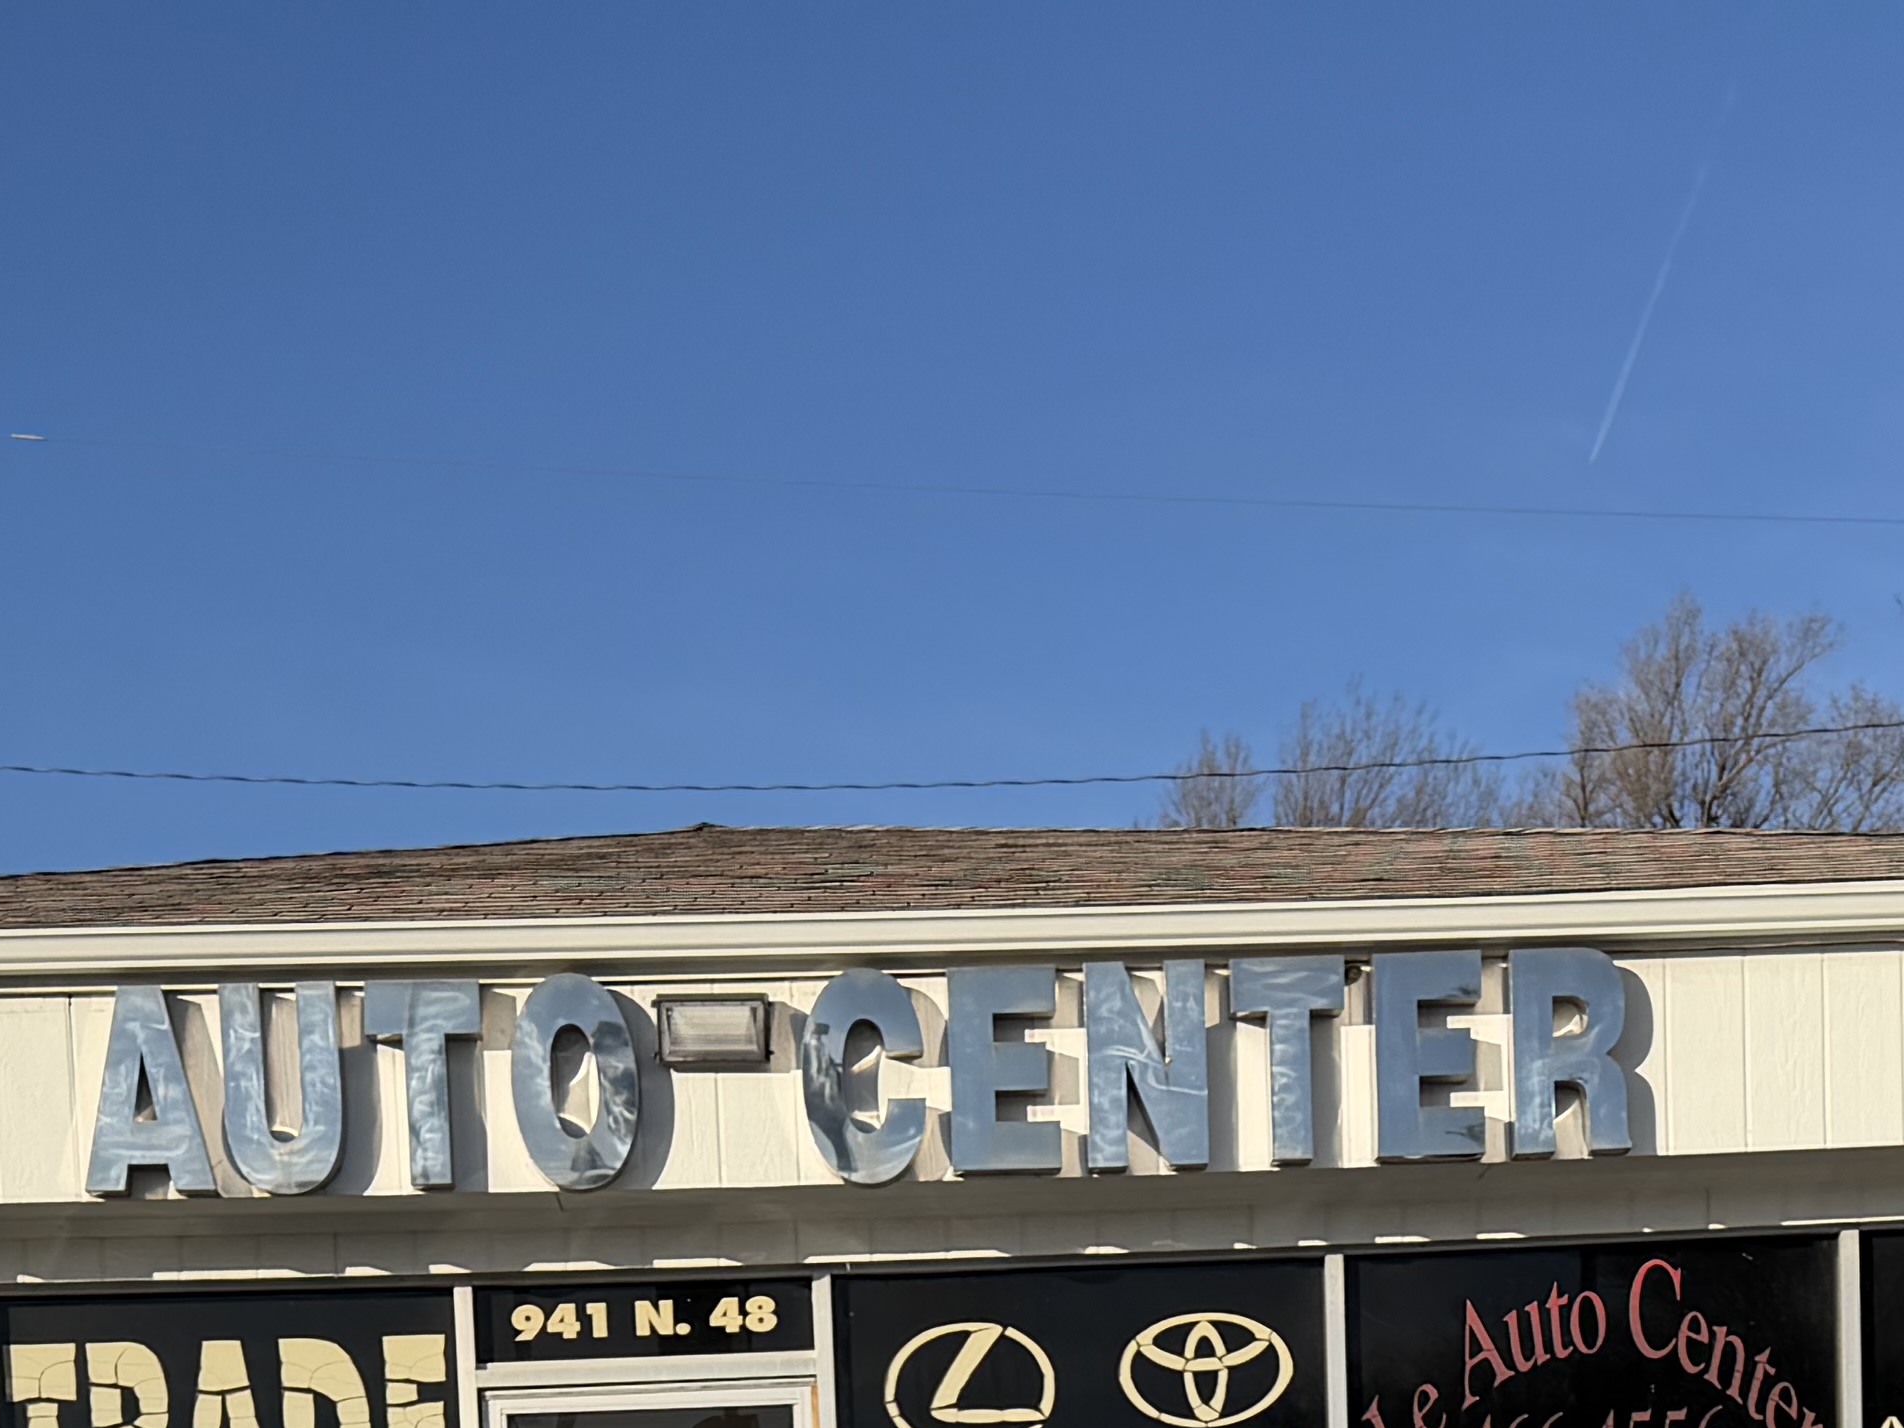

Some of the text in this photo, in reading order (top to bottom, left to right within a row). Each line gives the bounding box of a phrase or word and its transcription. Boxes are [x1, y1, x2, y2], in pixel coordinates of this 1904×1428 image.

[84, 972, 644, 1199] AUTO
[801, 948, 1632, 1189] CENTER
[510, 1295, 778, 1342] 941 N. 48
[1461, 1281, 1607, 1411] Auto
